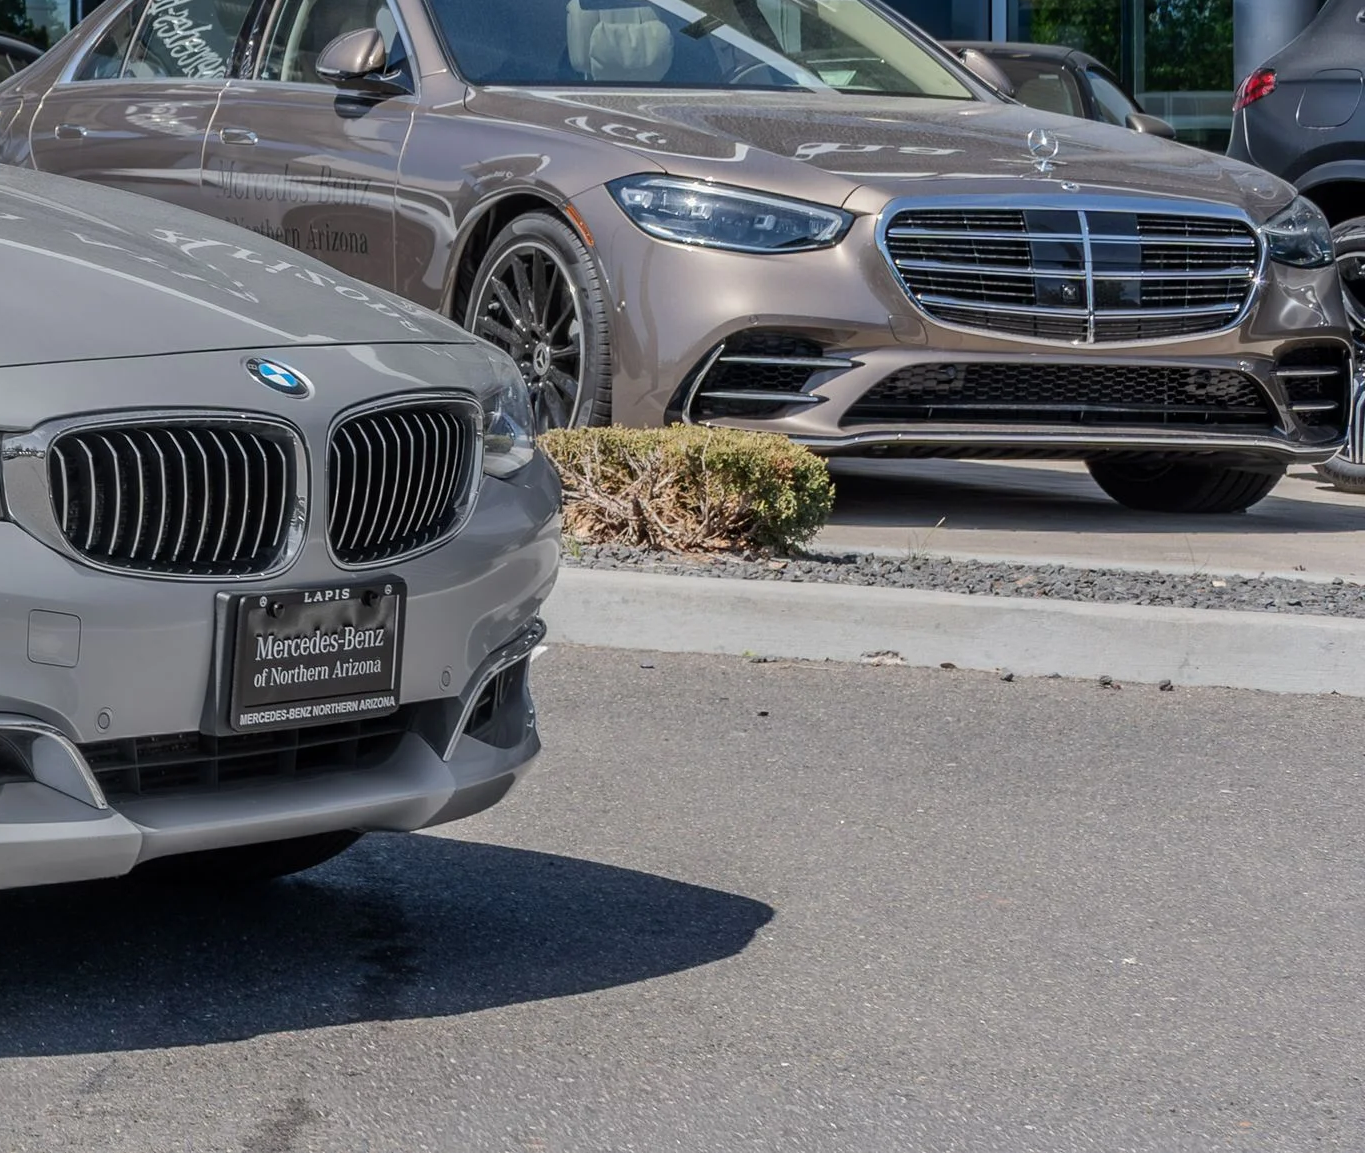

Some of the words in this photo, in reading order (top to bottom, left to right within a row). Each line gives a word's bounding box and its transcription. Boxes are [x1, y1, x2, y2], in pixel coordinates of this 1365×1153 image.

[217, 159, 372, 206] MercedesBenz
[306, 223, 369, 254] Arizona
[304, 588, 350, 603] LAPIS
[255, 626, 384, 660] Mercedes-Benz
[254, 667, 269, 688] of
[269, 664, 329, 686] Northern
[332, 658, 381, 678] Arizona
[239, 705, 311, 726] MERCEDES-BENZ
[312, 700, 358, 717] NORTHERN
[358, 695, 395, 712] ARIZONA
